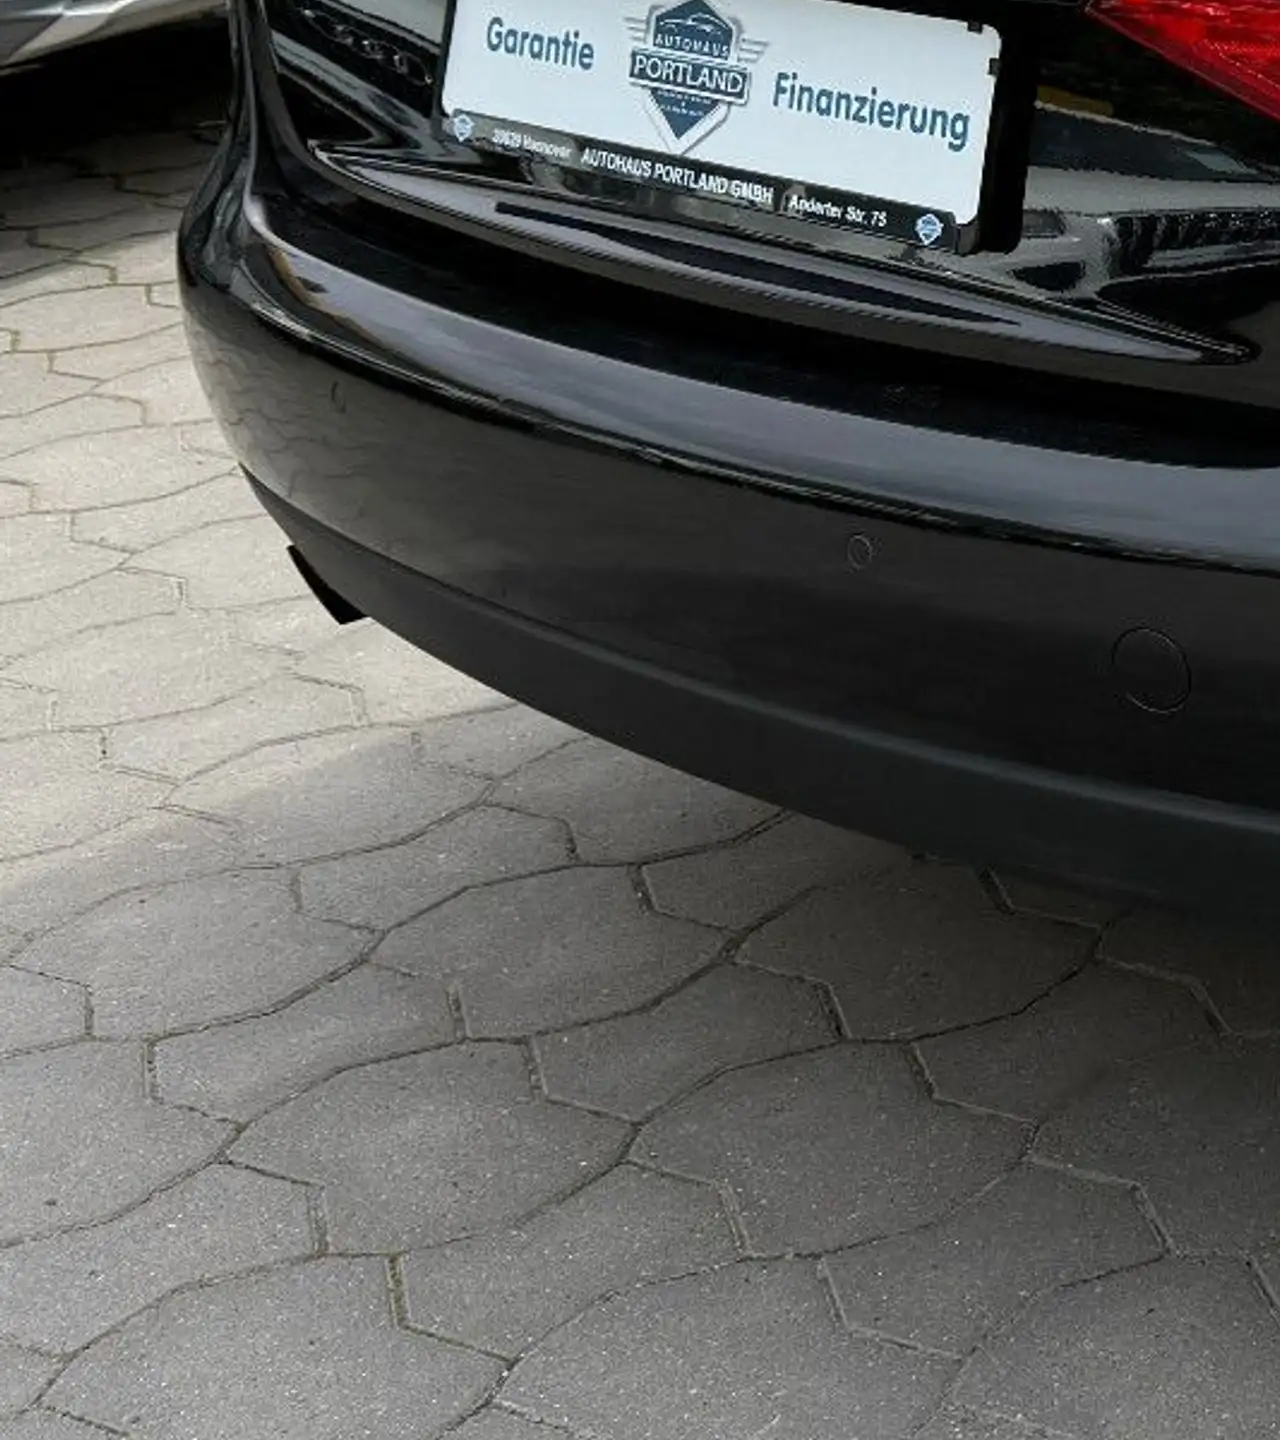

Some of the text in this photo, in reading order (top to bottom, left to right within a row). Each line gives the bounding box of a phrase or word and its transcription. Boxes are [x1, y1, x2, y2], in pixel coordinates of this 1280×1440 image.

[486, 16, 595, 71] Garantie
[655, 34, 729, 57] AUTOHAUS
[633, 54, 743, 92] PORTLAND
[772, 71, 970, 152] Finanzierung
[580, 146, 652, 179] AUTOHAUS
[654, 163, 728, 194] PORTLAND
